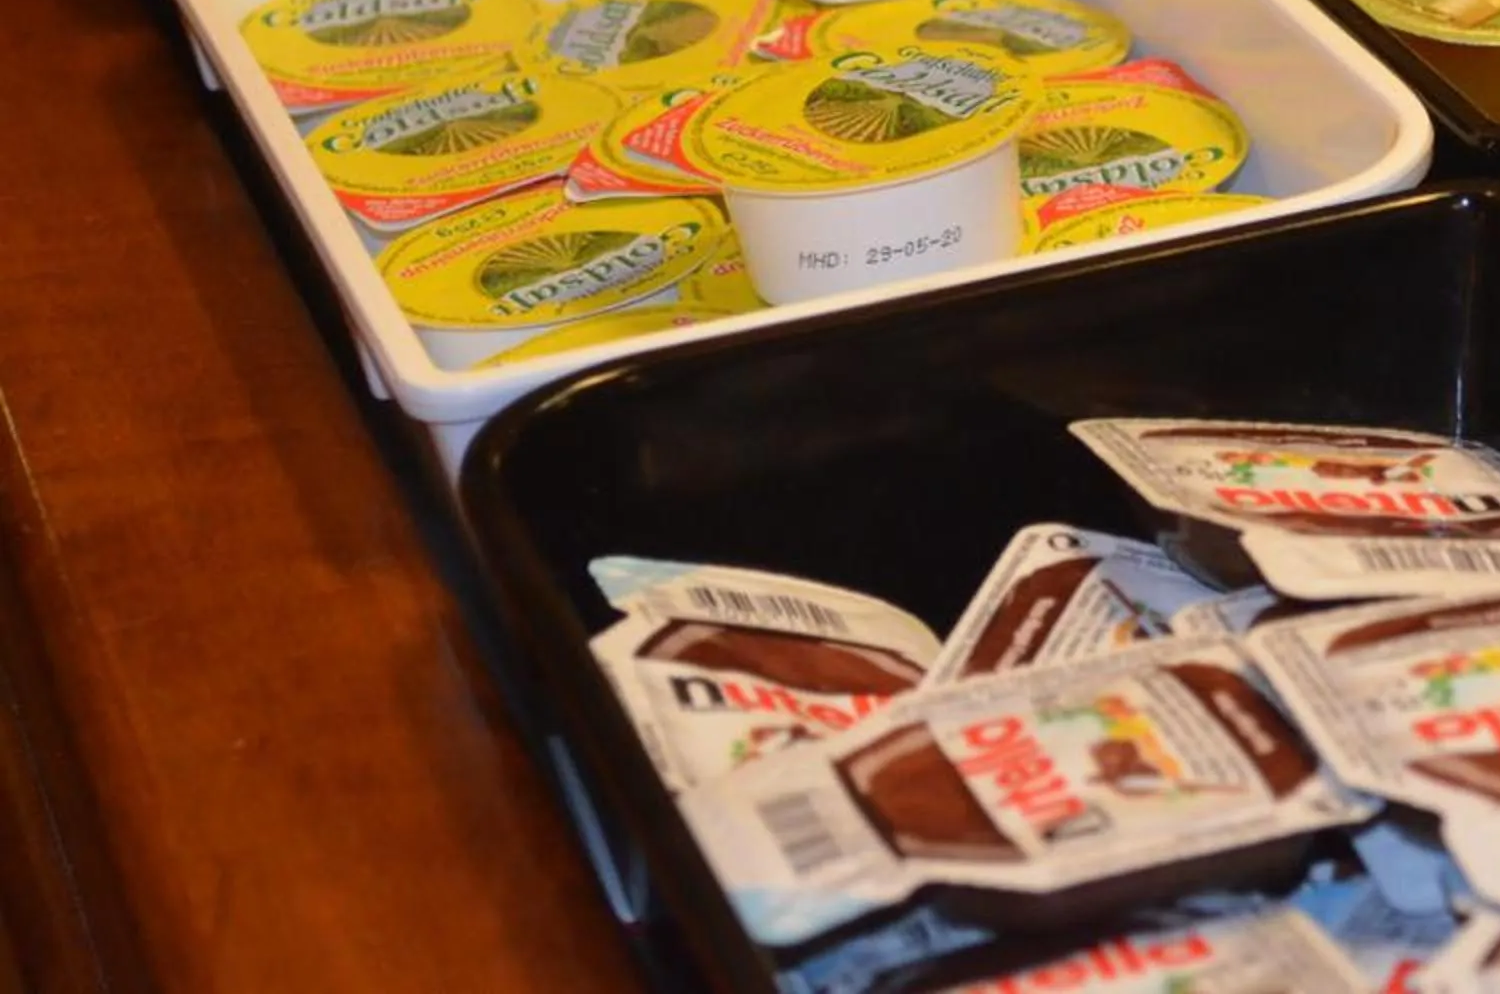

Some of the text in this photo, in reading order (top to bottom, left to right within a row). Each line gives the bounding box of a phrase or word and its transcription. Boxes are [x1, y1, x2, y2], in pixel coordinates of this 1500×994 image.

[489, 220, 702, 318] Goldsaft
[866, 225, 962, 266] 29-05-20
[669, 674, 892, 732] nutel
[958, 714, 1114, 839] nutella
[966, 928, 1215, 994] ella
